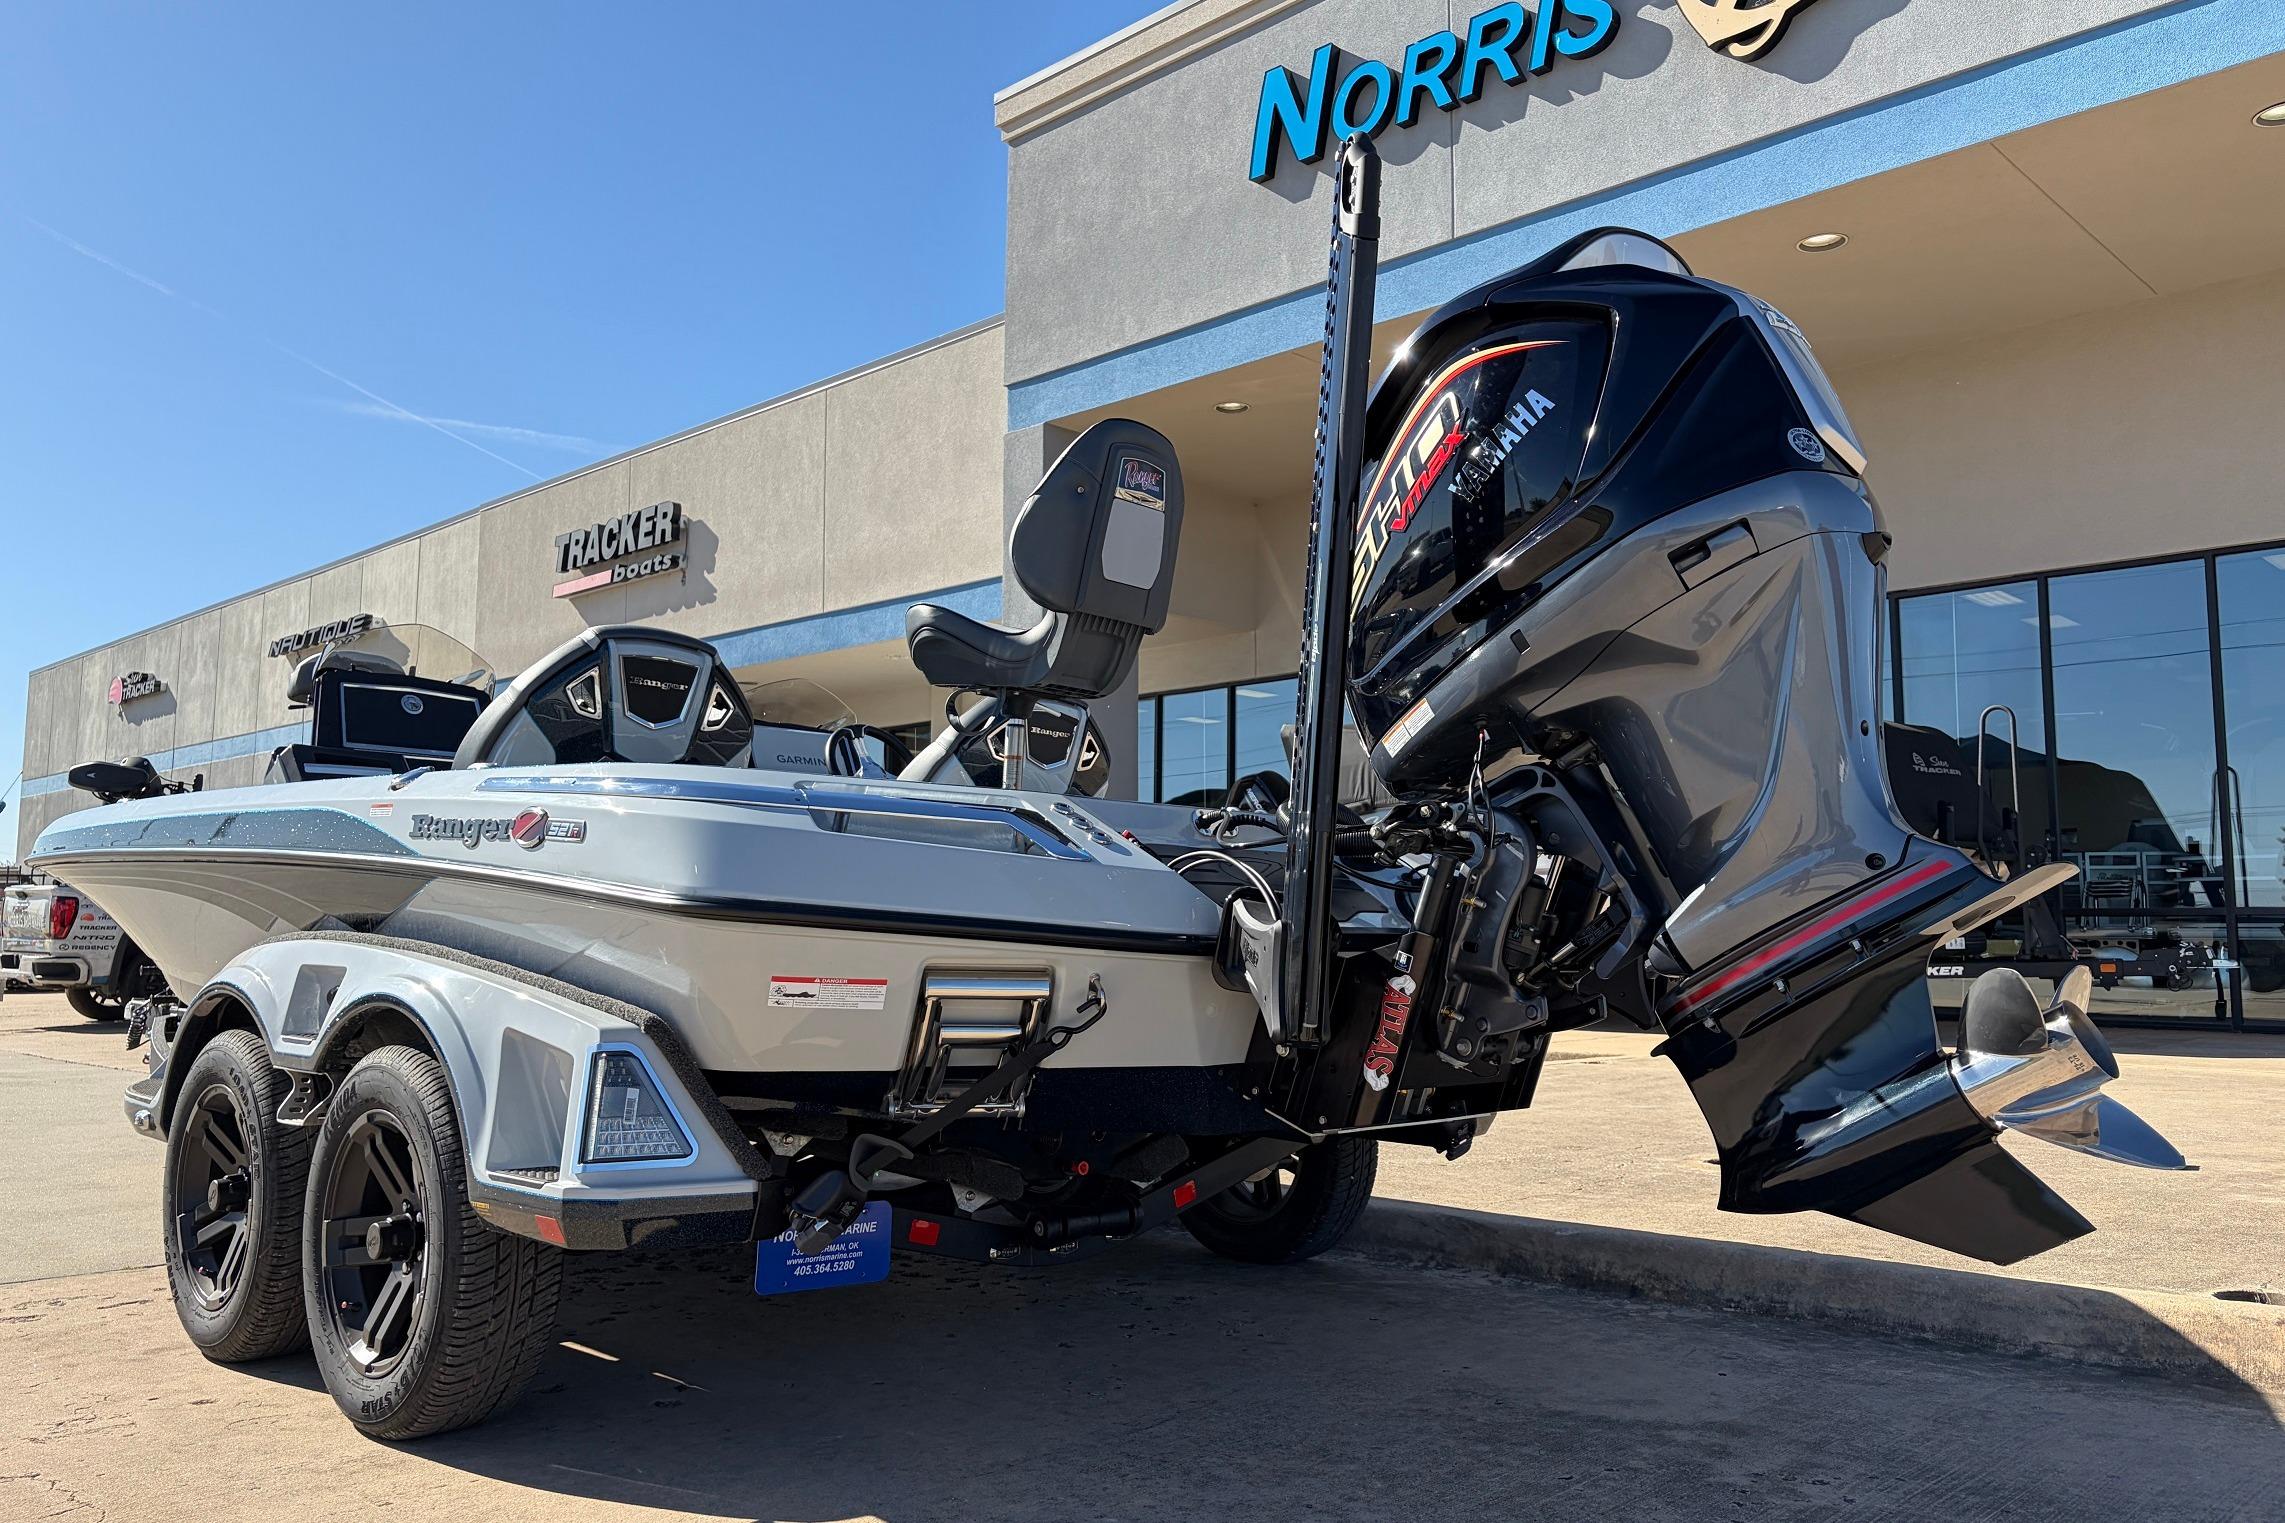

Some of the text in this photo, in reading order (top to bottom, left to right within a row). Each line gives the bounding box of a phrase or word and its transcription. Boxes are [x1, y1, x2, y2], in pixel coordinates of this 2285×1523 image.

[1249, 0, 1620, 184] NORRIS
[1448, 388, 1556, 503] YAMAHA
[555, 501, 677, 573] TRACKER
[613, 554, 672, 583] boats
[268, 613, 367, 658] NAUTIQUE
[122, 679, 156, 700] TRACKER
[629, 675, 688, 691] Ranger
[1030, 726, 1071, 738] Ranger
[776, 753, 826, 767] GARMIN
[1912, 764, 1962, 776] TRACKER
[409, 814, 514, 850] Ranger
[1364, 980, 1412, 1076] ATLAS
[841, 1221, 878, 1236] ARINE
[786, 1250, 863, 1265] www.norrismarine.com
[793, 1259, 855, 1276] 405.364.5280
